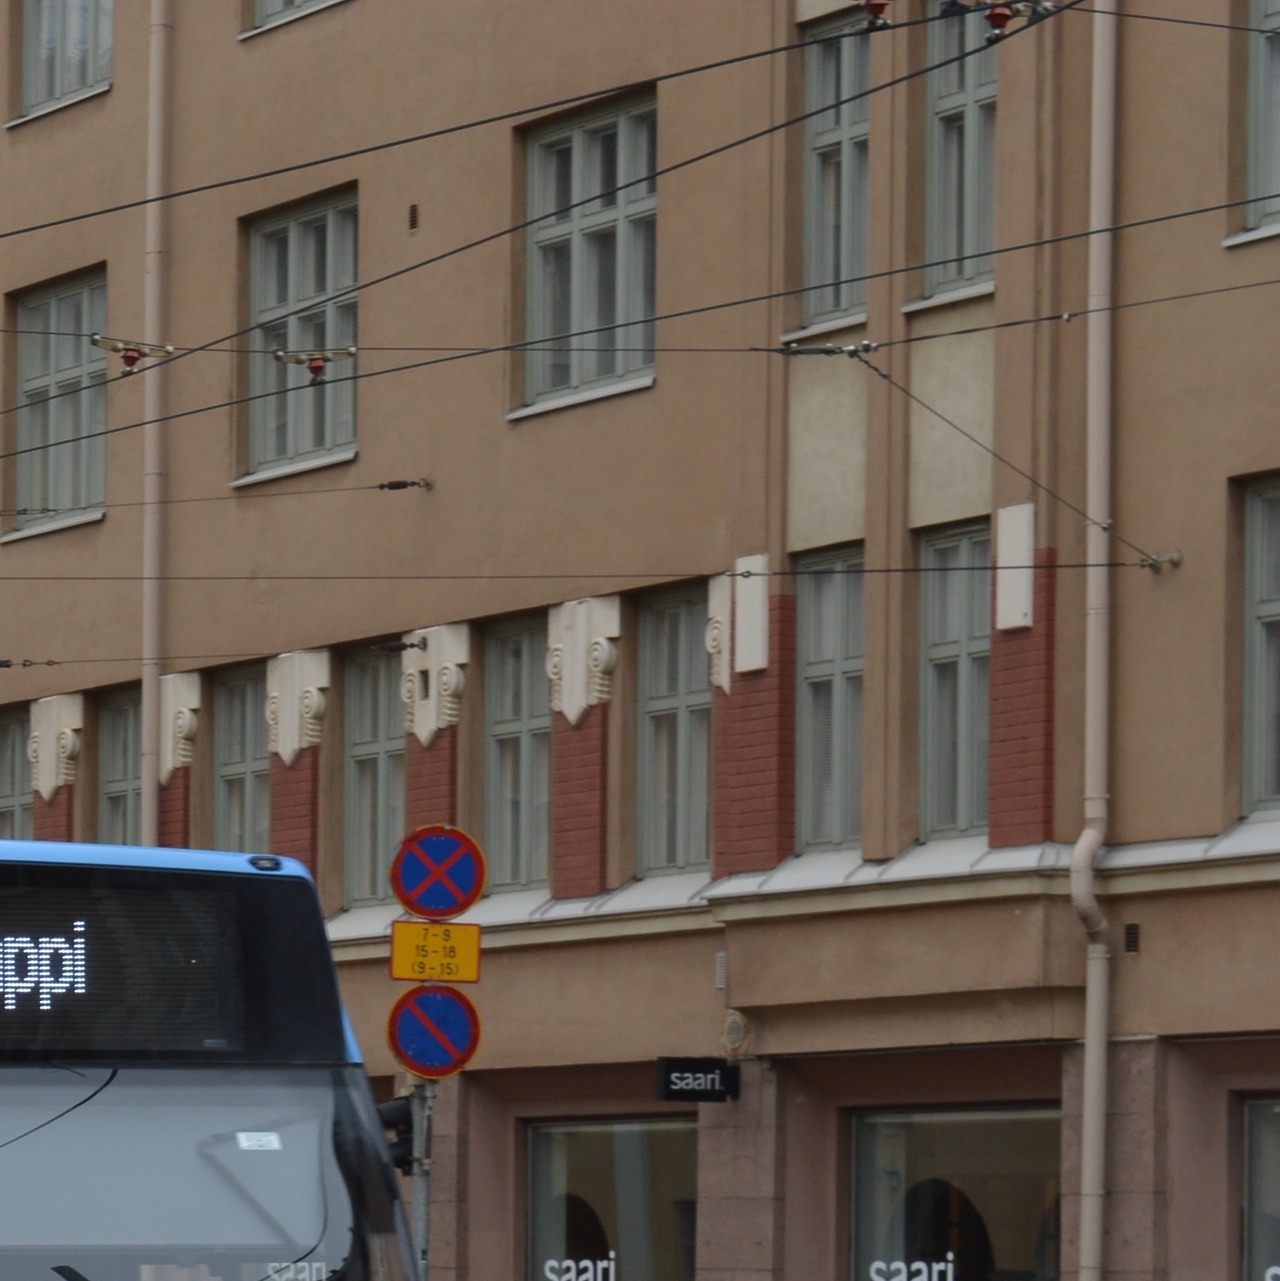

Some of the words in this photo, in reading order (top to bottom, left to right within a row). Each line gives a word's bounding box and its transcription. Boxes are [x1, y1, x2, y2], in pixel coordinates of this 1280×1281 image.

[422, 928, 429, 941] 7
[443, 928, 451, 942] 9
[415, 945, 429, 958] 15
[442, 946, 457, 959] 18
